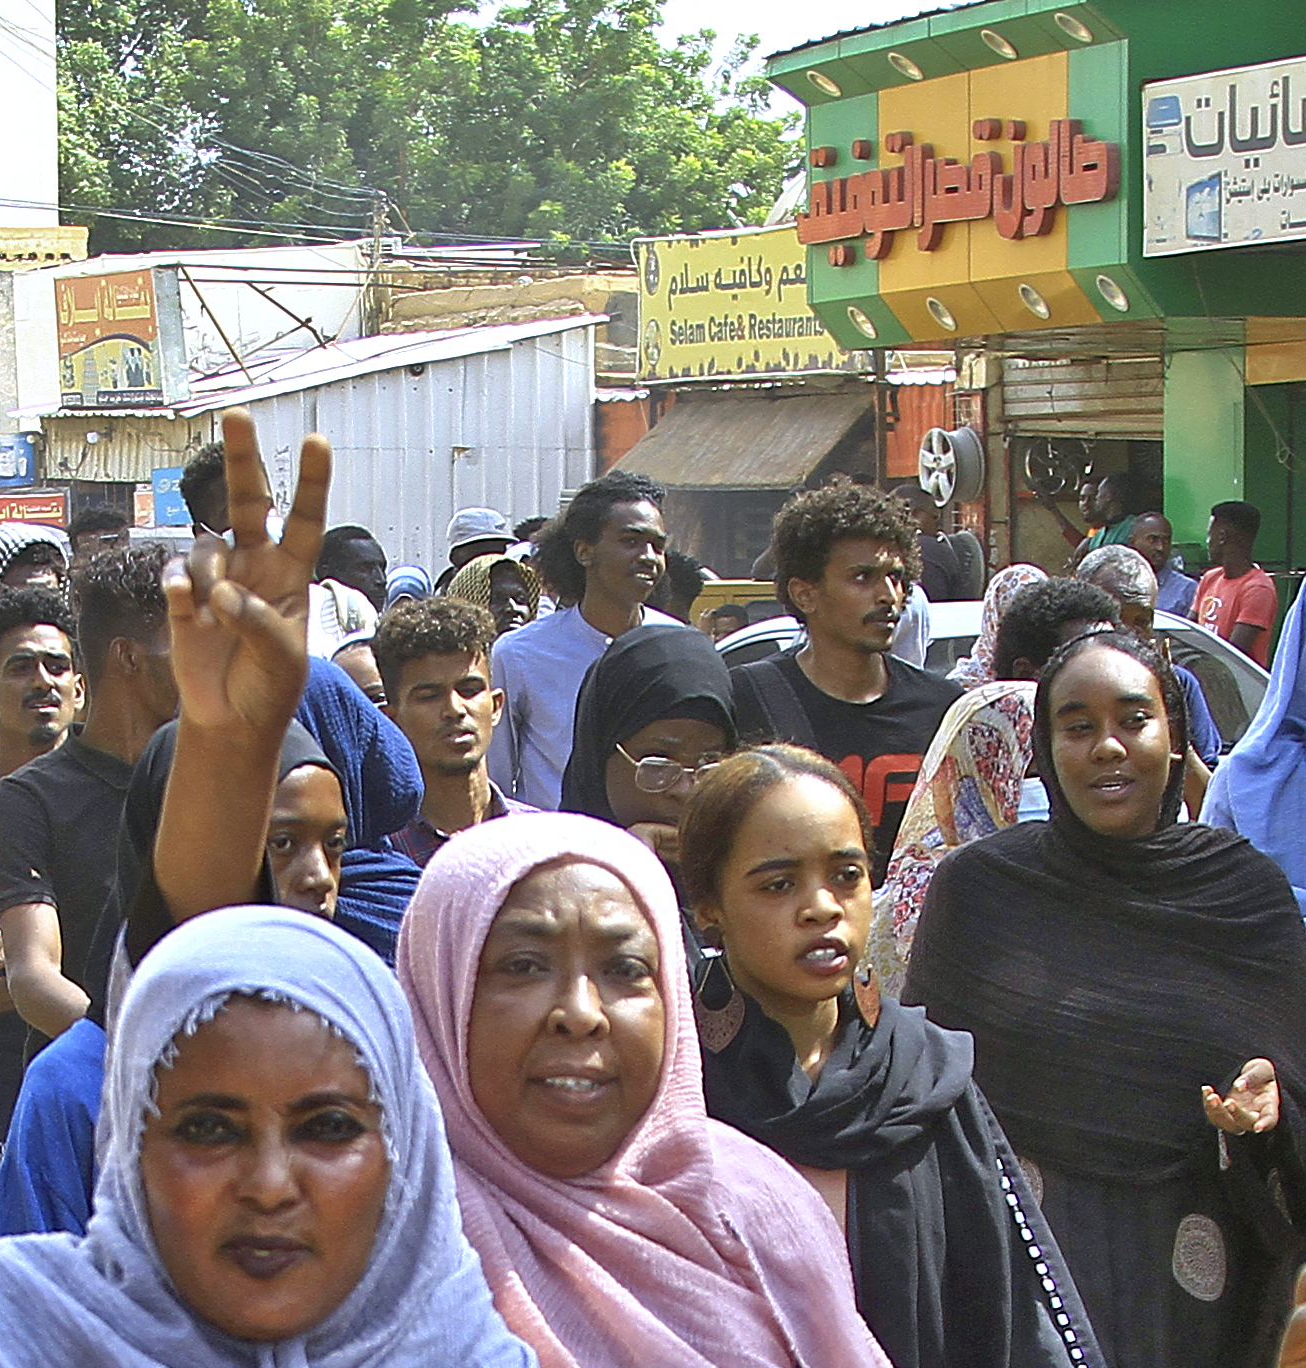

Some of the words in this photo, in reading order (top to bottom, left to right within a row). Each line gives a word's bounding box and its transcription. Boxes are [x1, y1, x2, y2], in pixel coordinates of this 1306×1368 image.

[667, 262, 710, 312] سلام
[777, 262, 807, 303] عم
[669, 318, 706, 345] Selam
